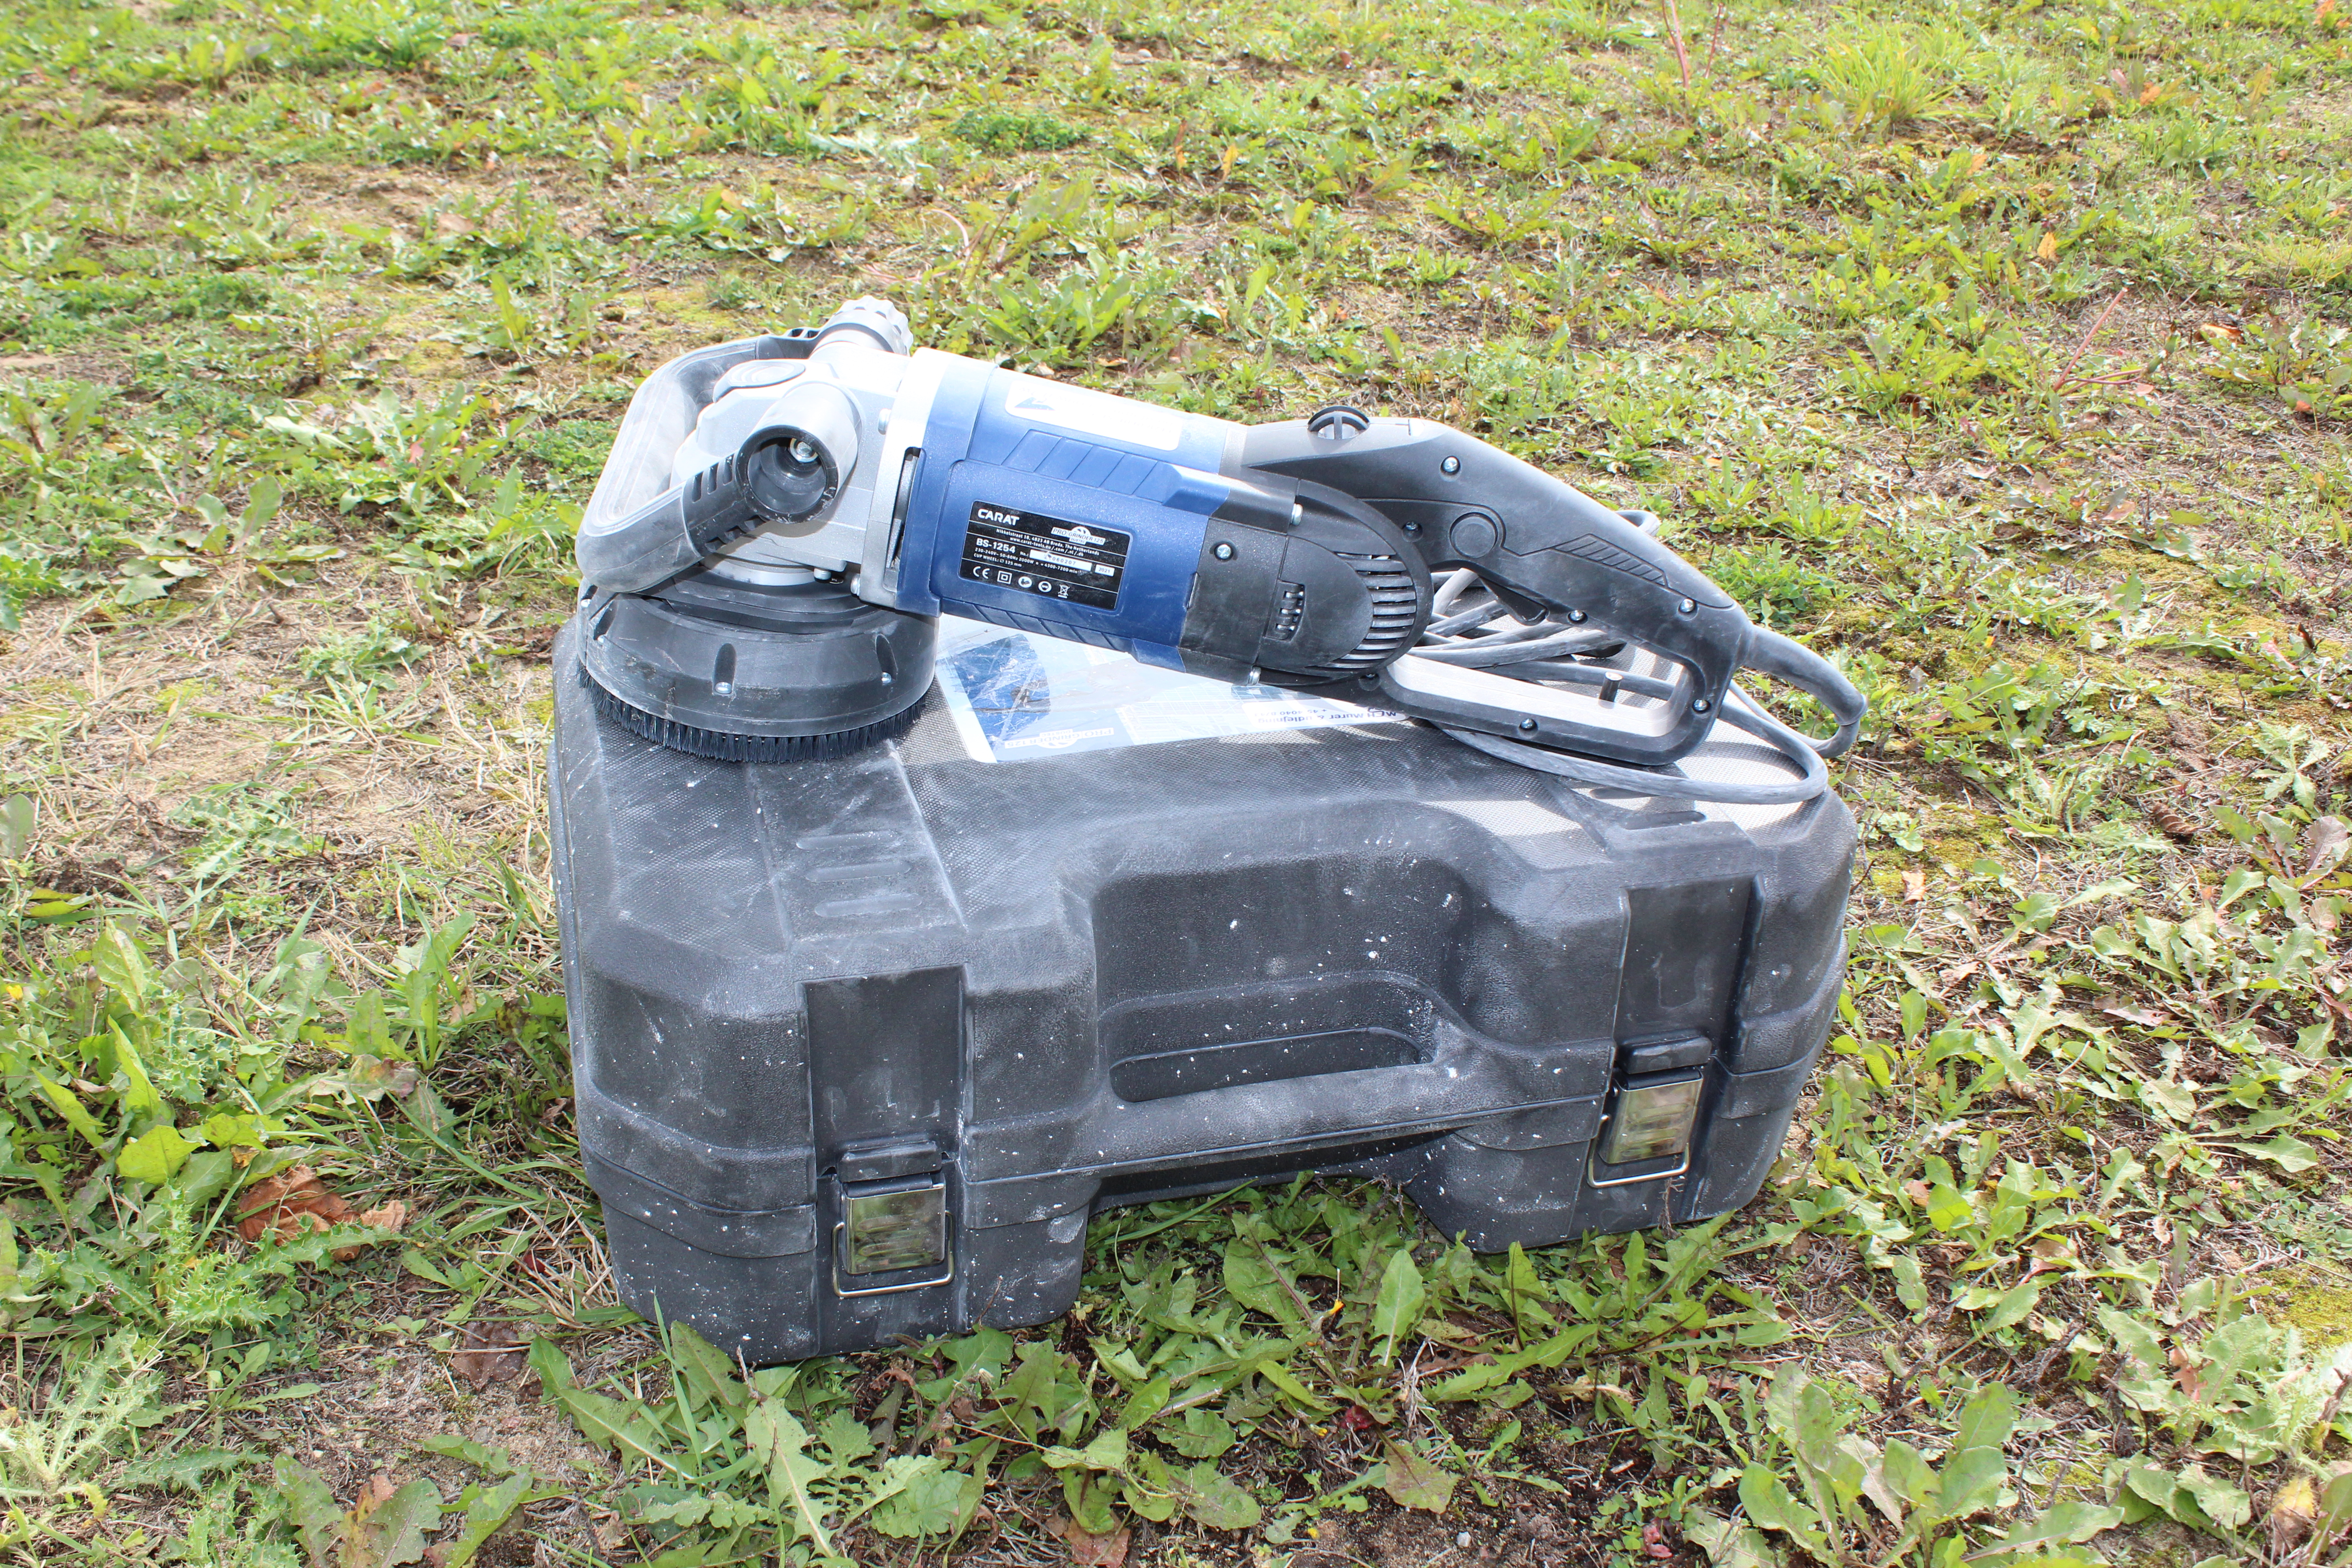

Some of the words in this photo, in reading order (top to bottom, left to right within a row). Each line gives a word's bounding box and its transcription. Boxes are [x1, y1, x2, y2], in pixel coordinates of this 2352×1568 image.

[978, 509, 1019, 526] CARAT
[996, 529, 1023, 538] Nikkelstraat
[1073, 546, 1100, 556] Netherlands
[1068, 531, 1093, 541] GRINDER
[976, 538, 1016, 553] BS-1254
[973, 566, 990, 579] CE
[1044, 563, 1068, 571] 4300-7200
[1030, 734, 1080, 744] GRINDER
